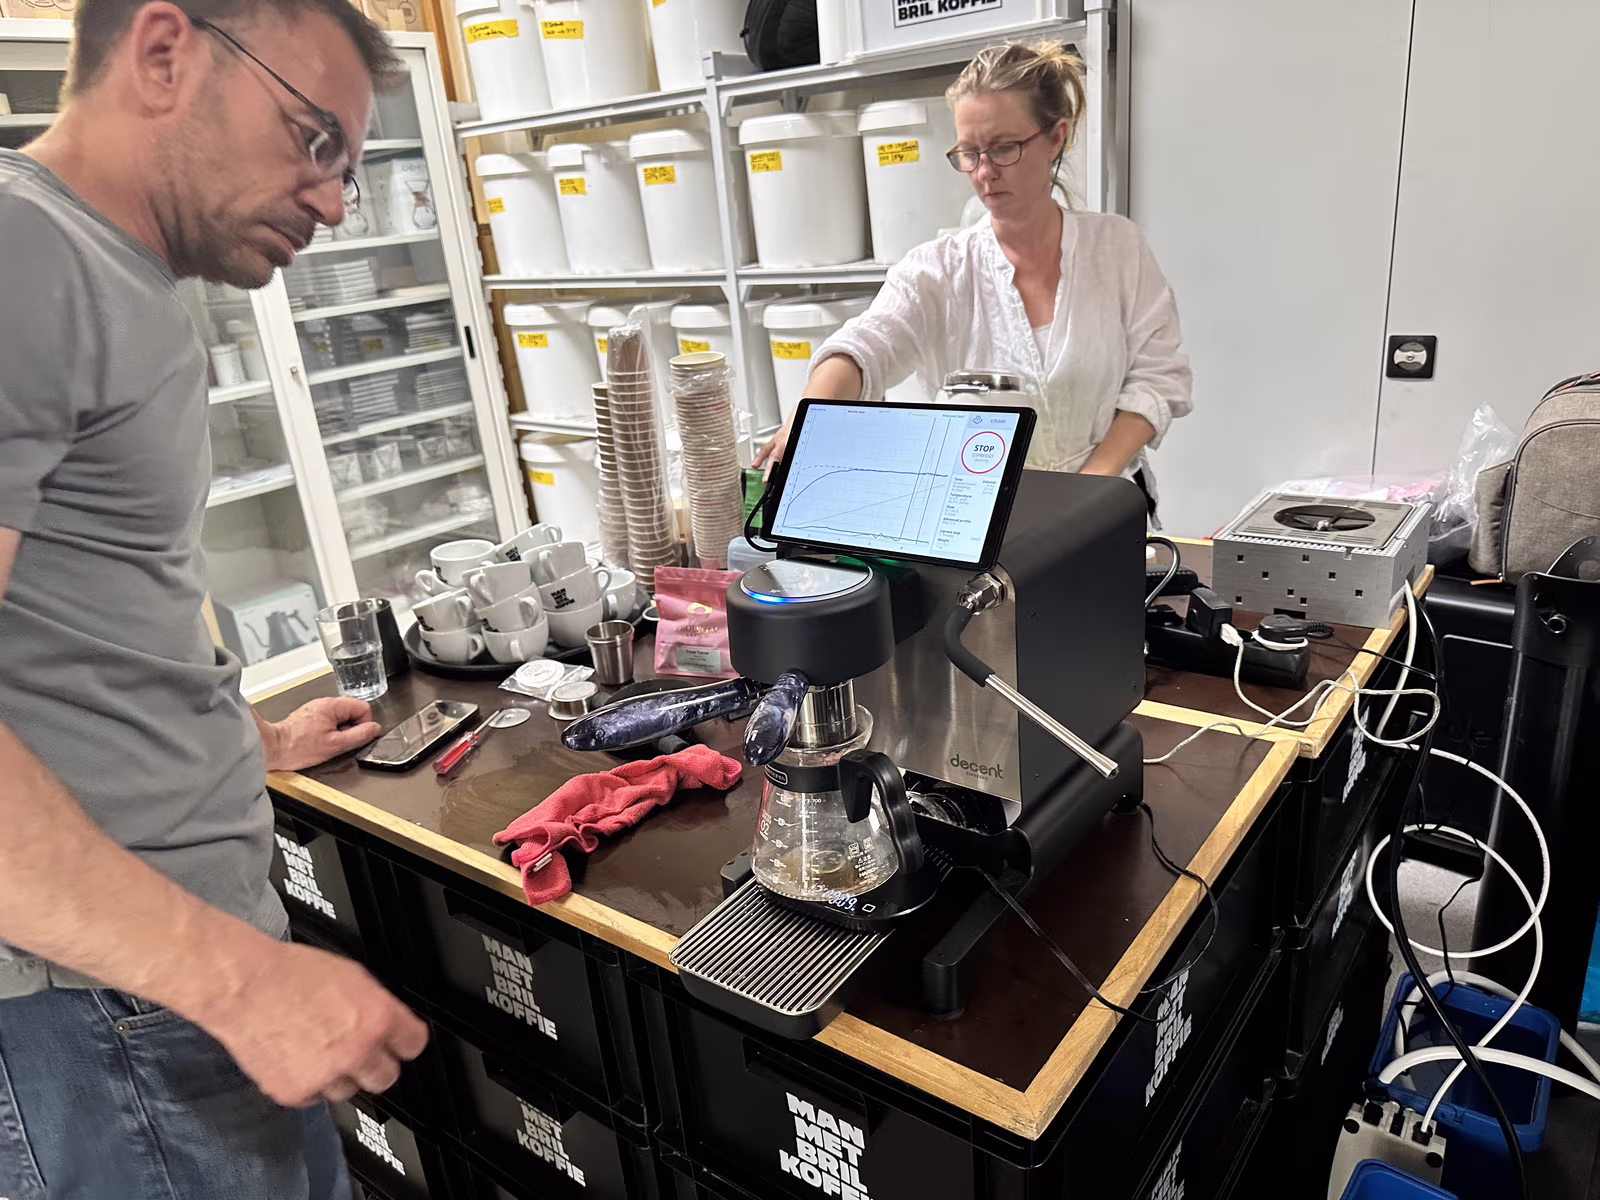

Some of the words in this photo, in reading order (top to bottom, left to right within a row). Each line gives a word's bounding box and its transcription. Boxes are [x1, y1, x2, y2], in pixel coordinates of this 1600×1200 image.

[898, 2, 932, 21] BRIL
[974, 444, 995, 452] STOP
[950, 753, 1003, 780] decent
[274, 832, 313, 864] MAN
[282, 849, 315, 879] MET
[283, 878, 337, 920] KOFFIE
[287, 866, 323, 897] BRIL
[482, 933, 534, 975] MAN
[489, 953, 533, 991] MET
[485, 985, 558, 1041] KOFFIE
[493, 972, 541, 1013] BRIL
[1145, 1013, 1192, 1108] KOFFIE
[360, 1120, 393, 1155] BRIL
[520, 1102, 563, 1141] MET
[524, 1119, 570, 1161] BRIL
[786, 1091, 865, 1150] MAN
[794, 1115, 863, 1167] MET
[355, 1128, 406, 1177] KOFFIE
[516, 1128, 586, 1188] KOFFIE
[796, 1136, 868, 1194] BRIL
